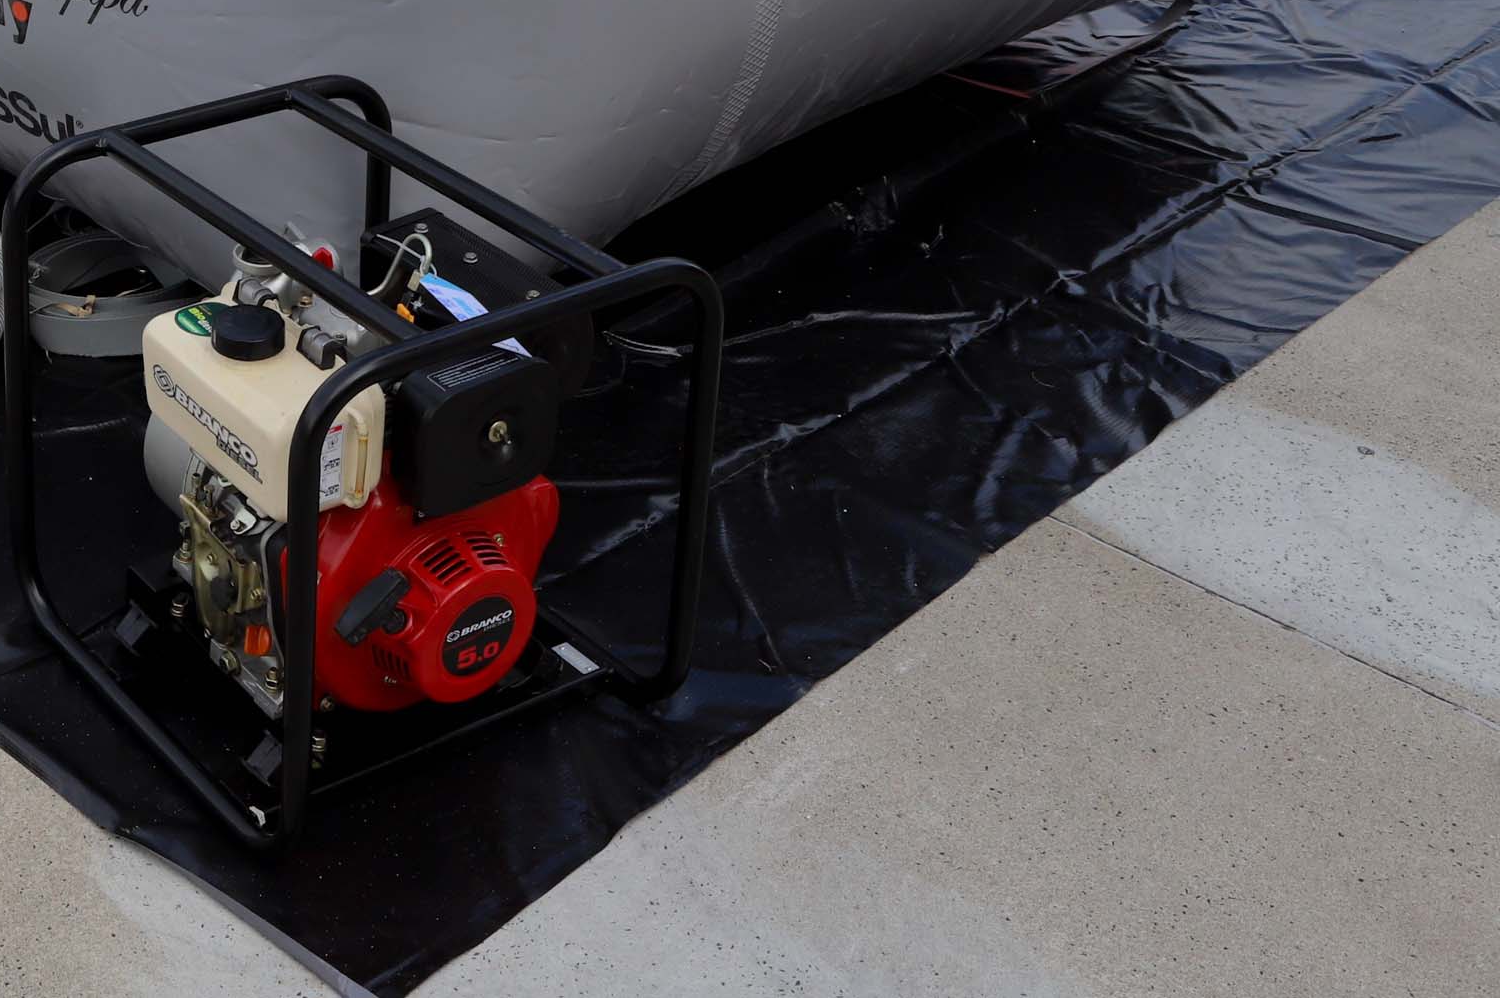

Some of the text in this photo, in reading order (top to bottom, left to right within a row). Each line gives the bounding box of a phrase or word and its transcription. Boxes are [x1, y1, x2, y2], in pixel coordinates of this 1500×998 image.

[174, 384, 258, 468] BRANCO
[460, 609, 512, 637] BRANCO
[457, 641, 500, 670] 5.0
